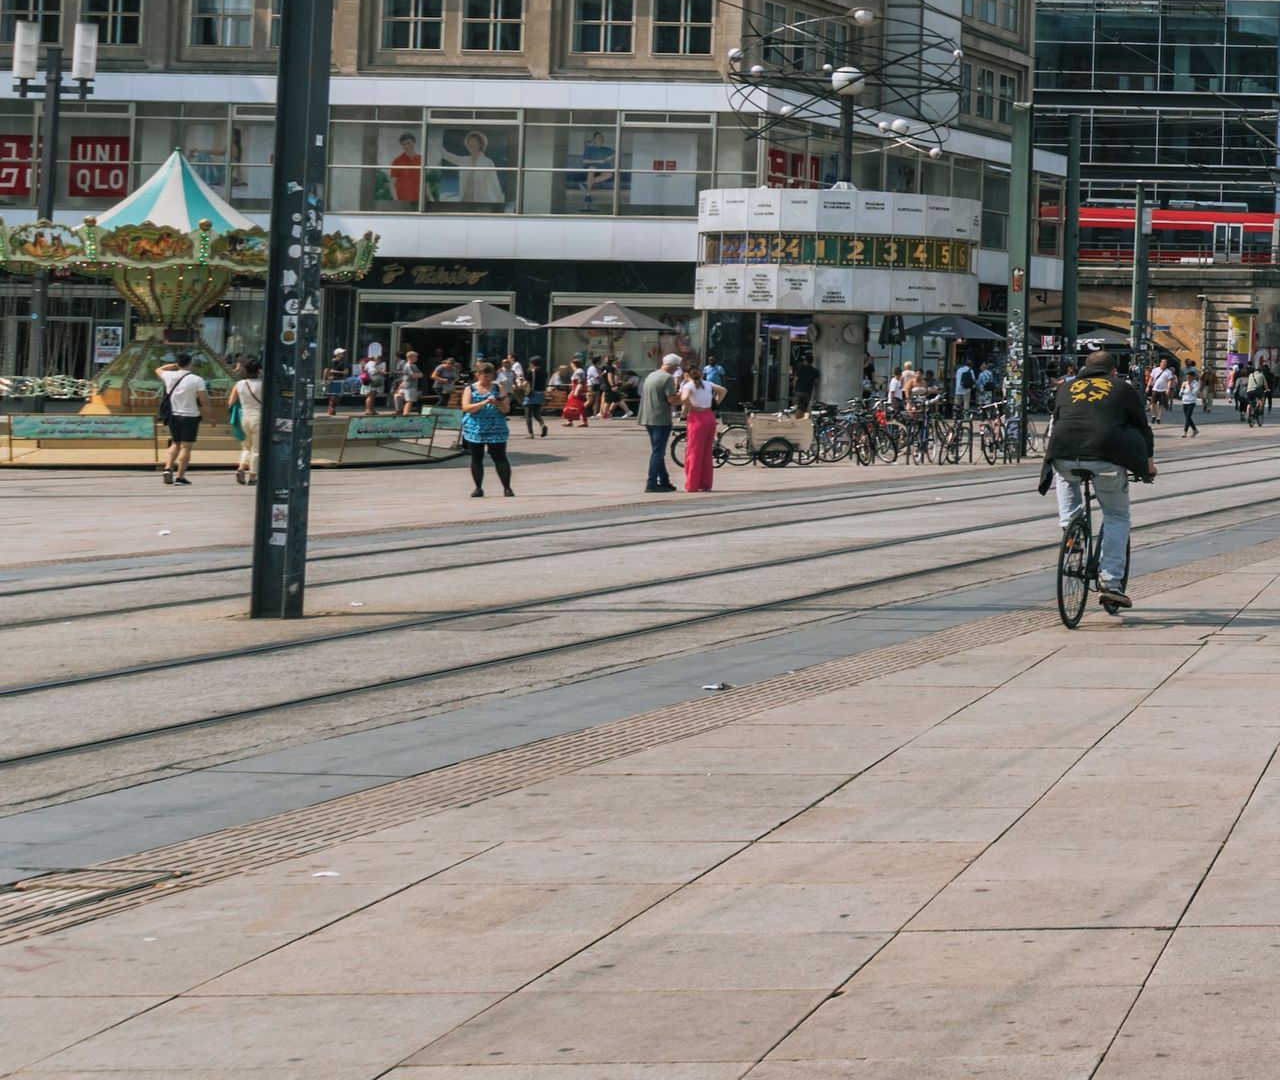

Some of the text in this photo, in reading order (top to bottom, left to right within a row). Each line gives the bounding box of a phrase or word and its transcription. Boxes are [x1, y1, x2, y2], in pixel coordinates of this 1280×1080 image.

[78, 144, 121, 161] UNI
[76, 169, 124, 193] QLO
[744, 238, 767, 258] 23
[771, 238, 799, 258] 24
[847, 241, 864, 260] 2
[884, 242, 897, 261] 3
[913, 243, 927, 263] 4
[941, 245, 950, 265] 5
[959, 247, 966, 265] 6
[411, 265, 488, 285] Tchibo
